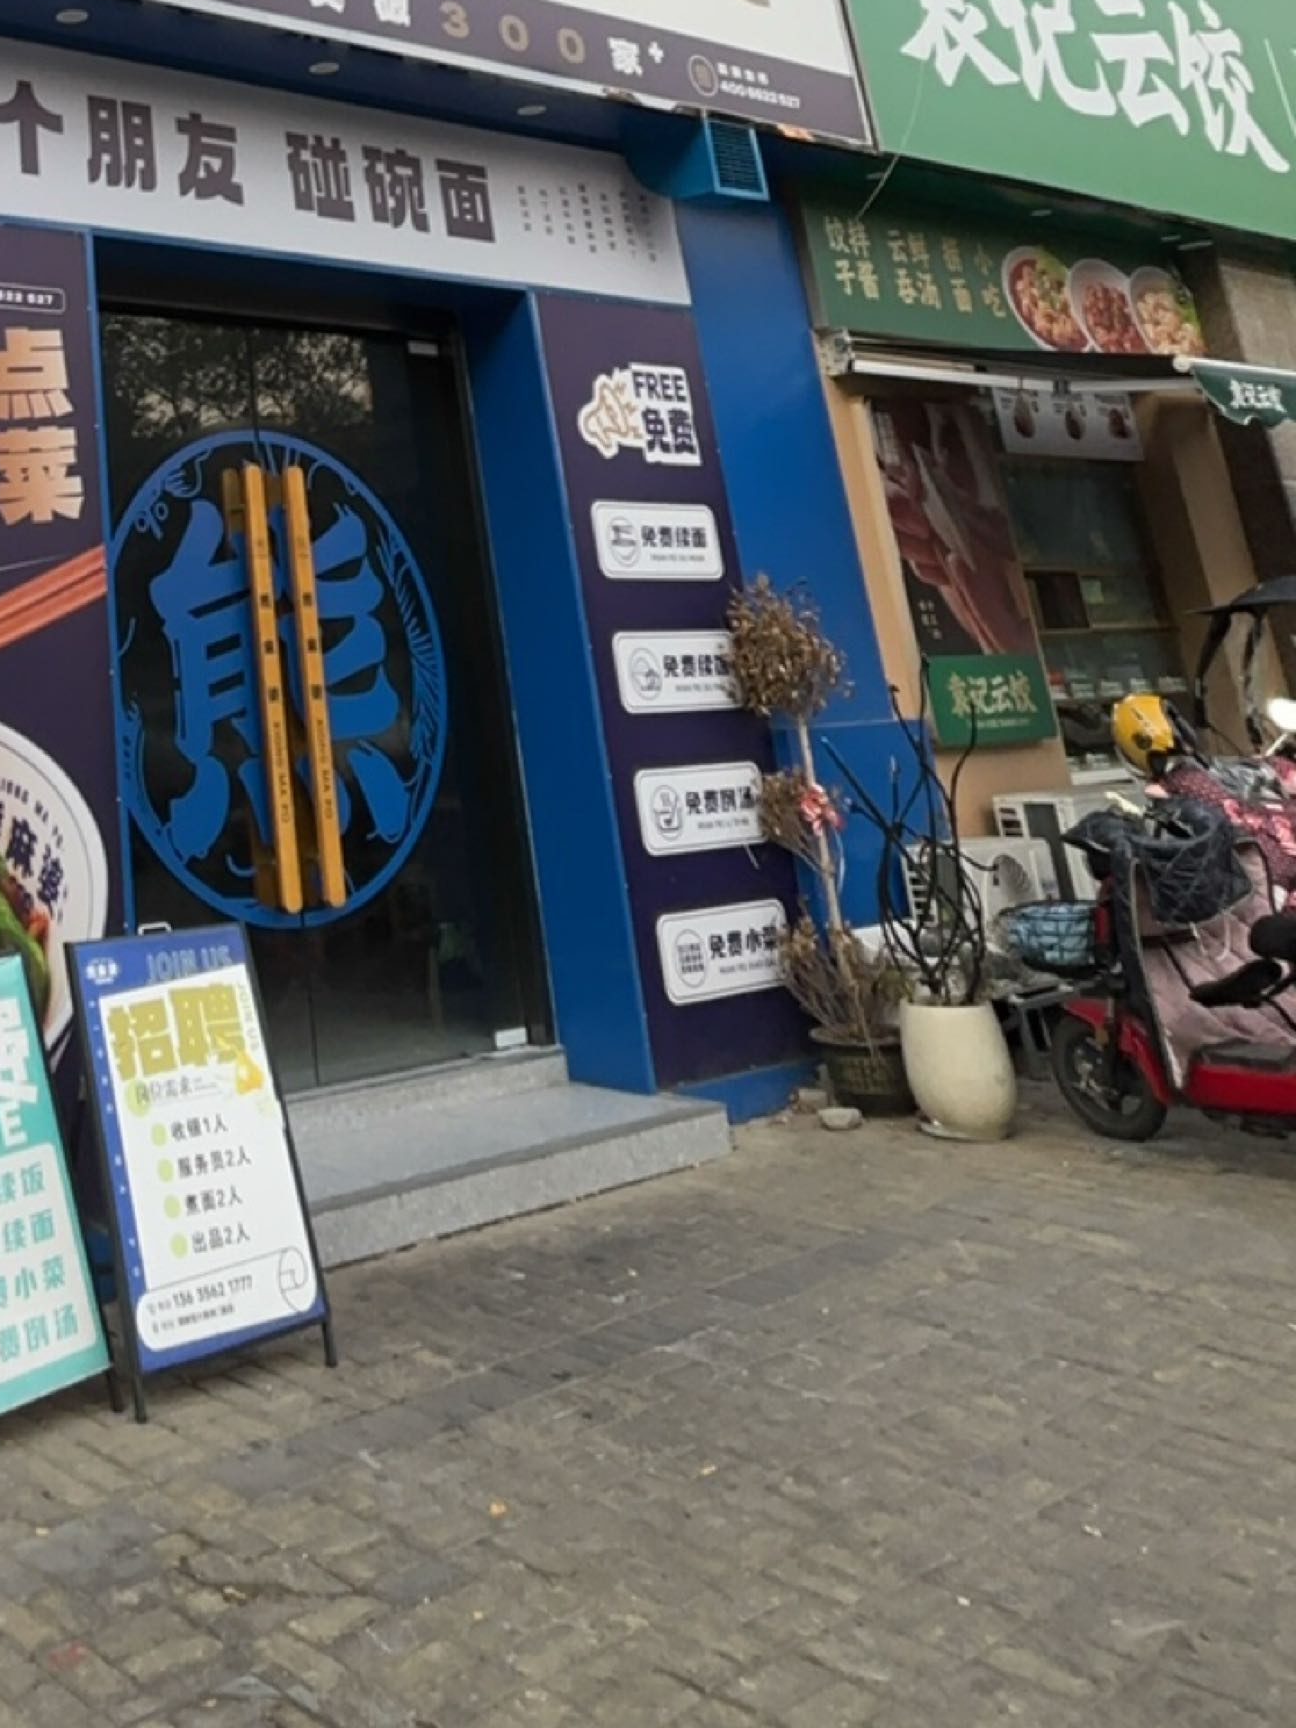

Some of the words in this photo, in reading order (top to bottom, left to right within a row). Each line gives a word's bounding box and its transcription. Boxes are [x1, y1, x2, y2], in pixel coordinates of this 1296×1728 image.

[284, 128, 497, 245] 碰碗面
[632, 372, 689, 403] FREE
[641, 408, 698, 455] 免费
[146, 949, 198, 983] JOIN
[107, 982, 246, 1082] 招聘
